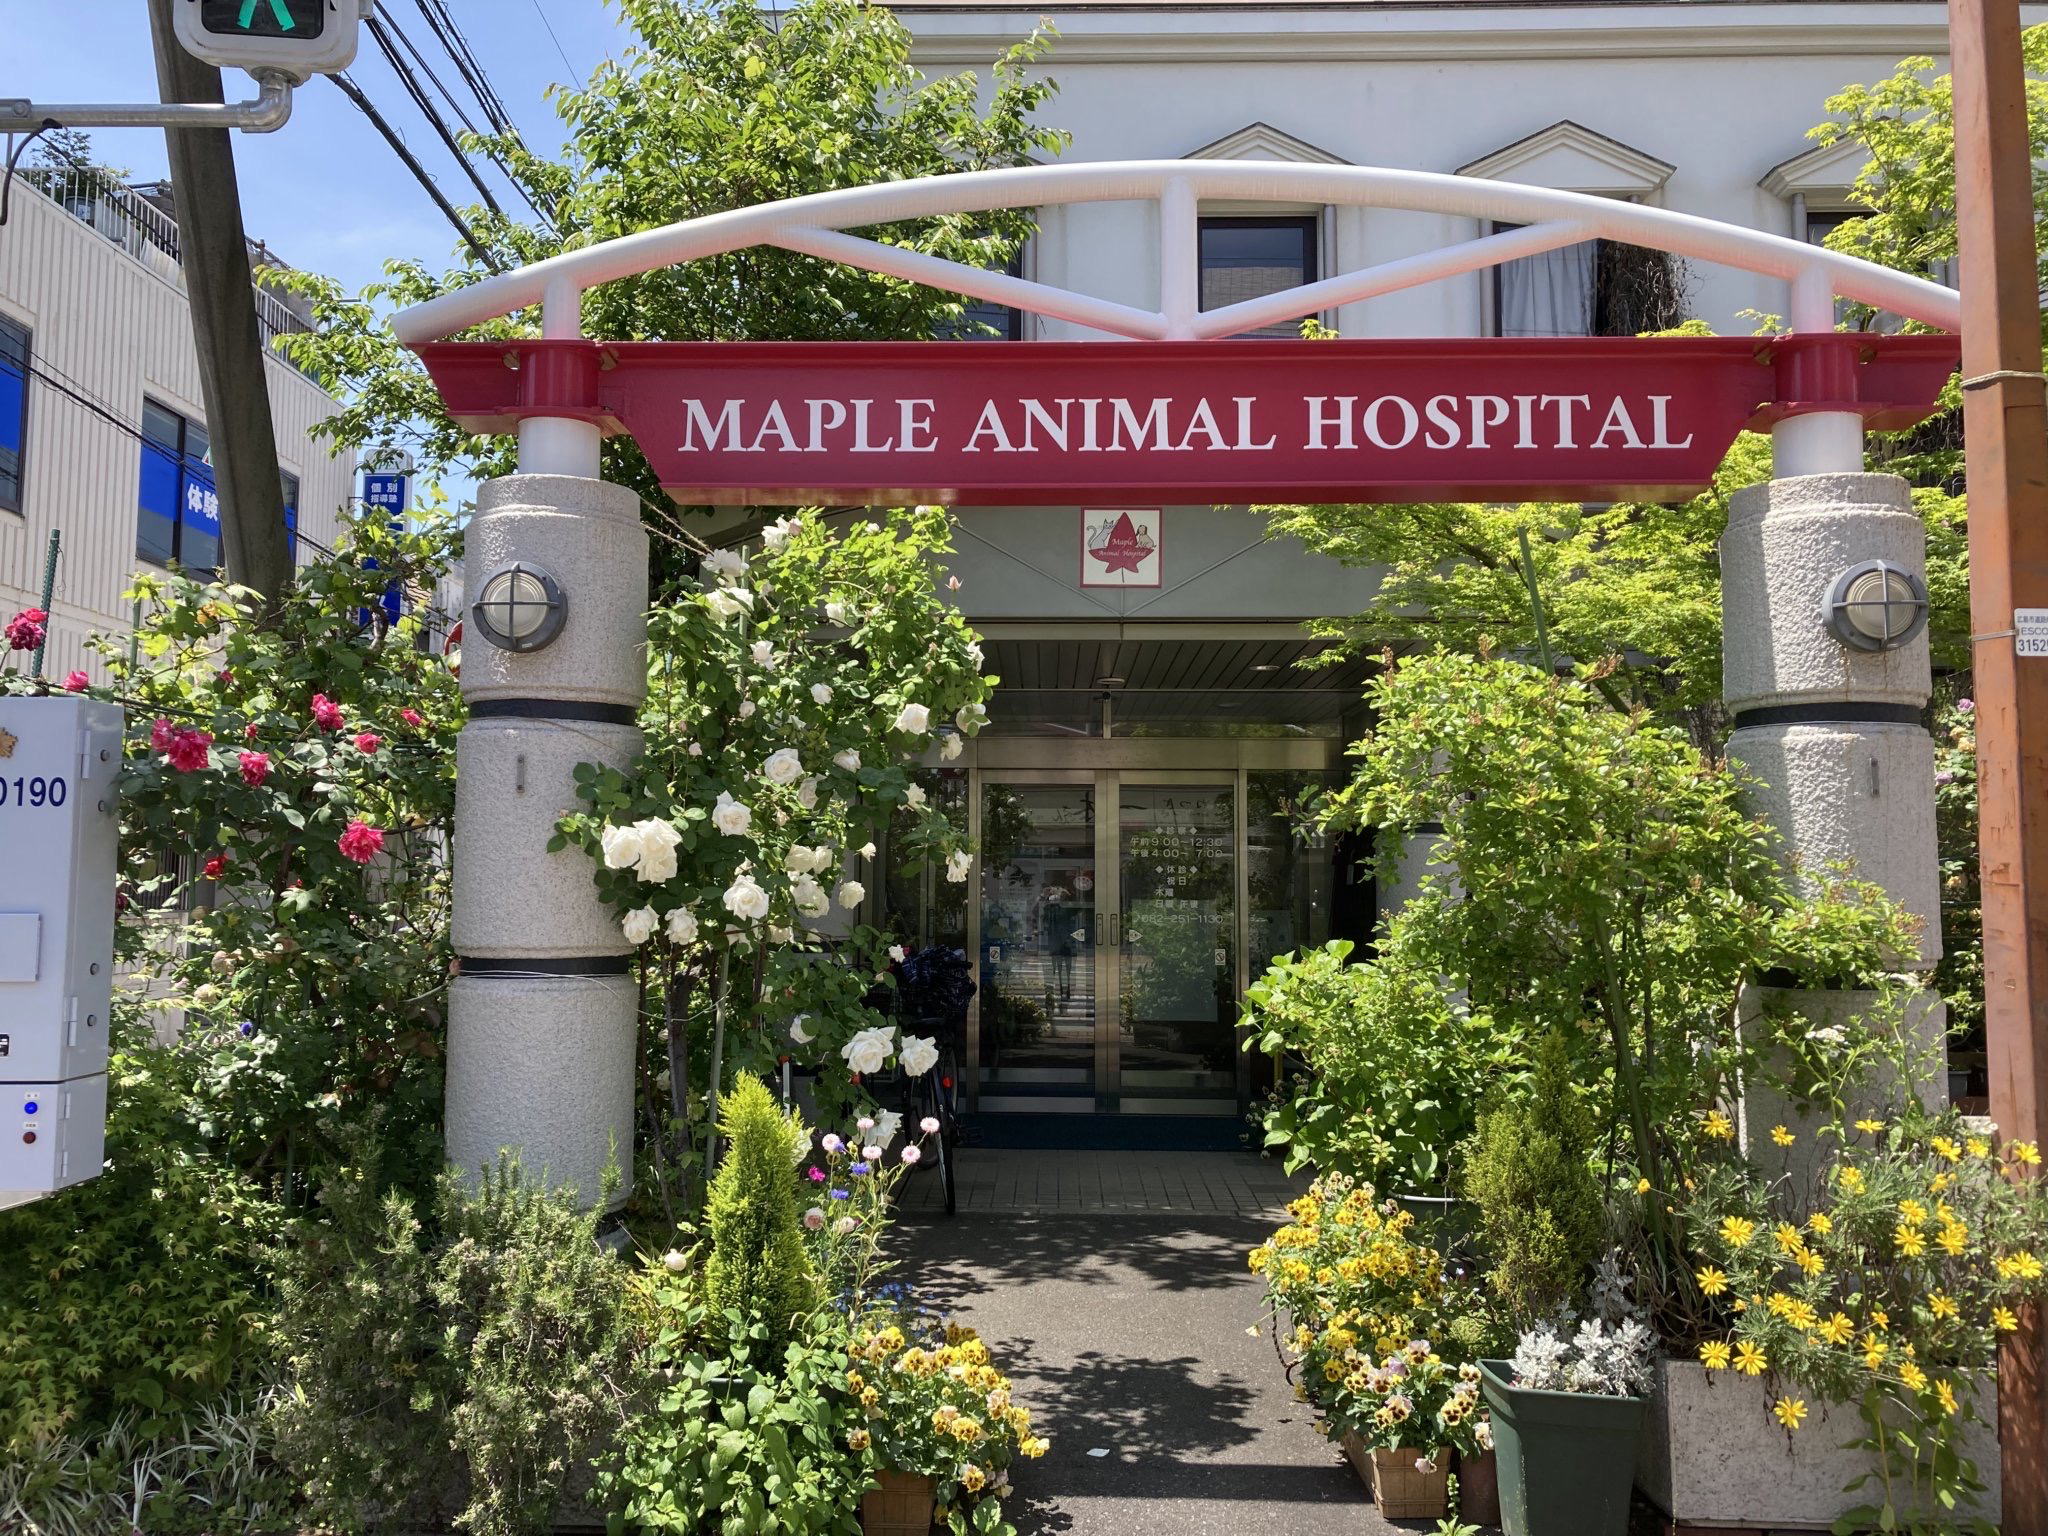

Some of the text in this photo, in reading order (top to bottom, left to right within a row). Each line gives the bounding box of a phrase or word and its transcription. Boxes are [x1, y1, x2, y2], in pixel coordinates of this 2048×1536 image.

[677, 395, 1694, 453] MAPLE ANIMAL HOSPITAL
[1112, 537, 1134, 548] Maple
[1122, 549, 1147, 559] Hospital
[2017, 615, 2048, 624] 広島市道路
[2018, 639, 2048, 652] 3152
